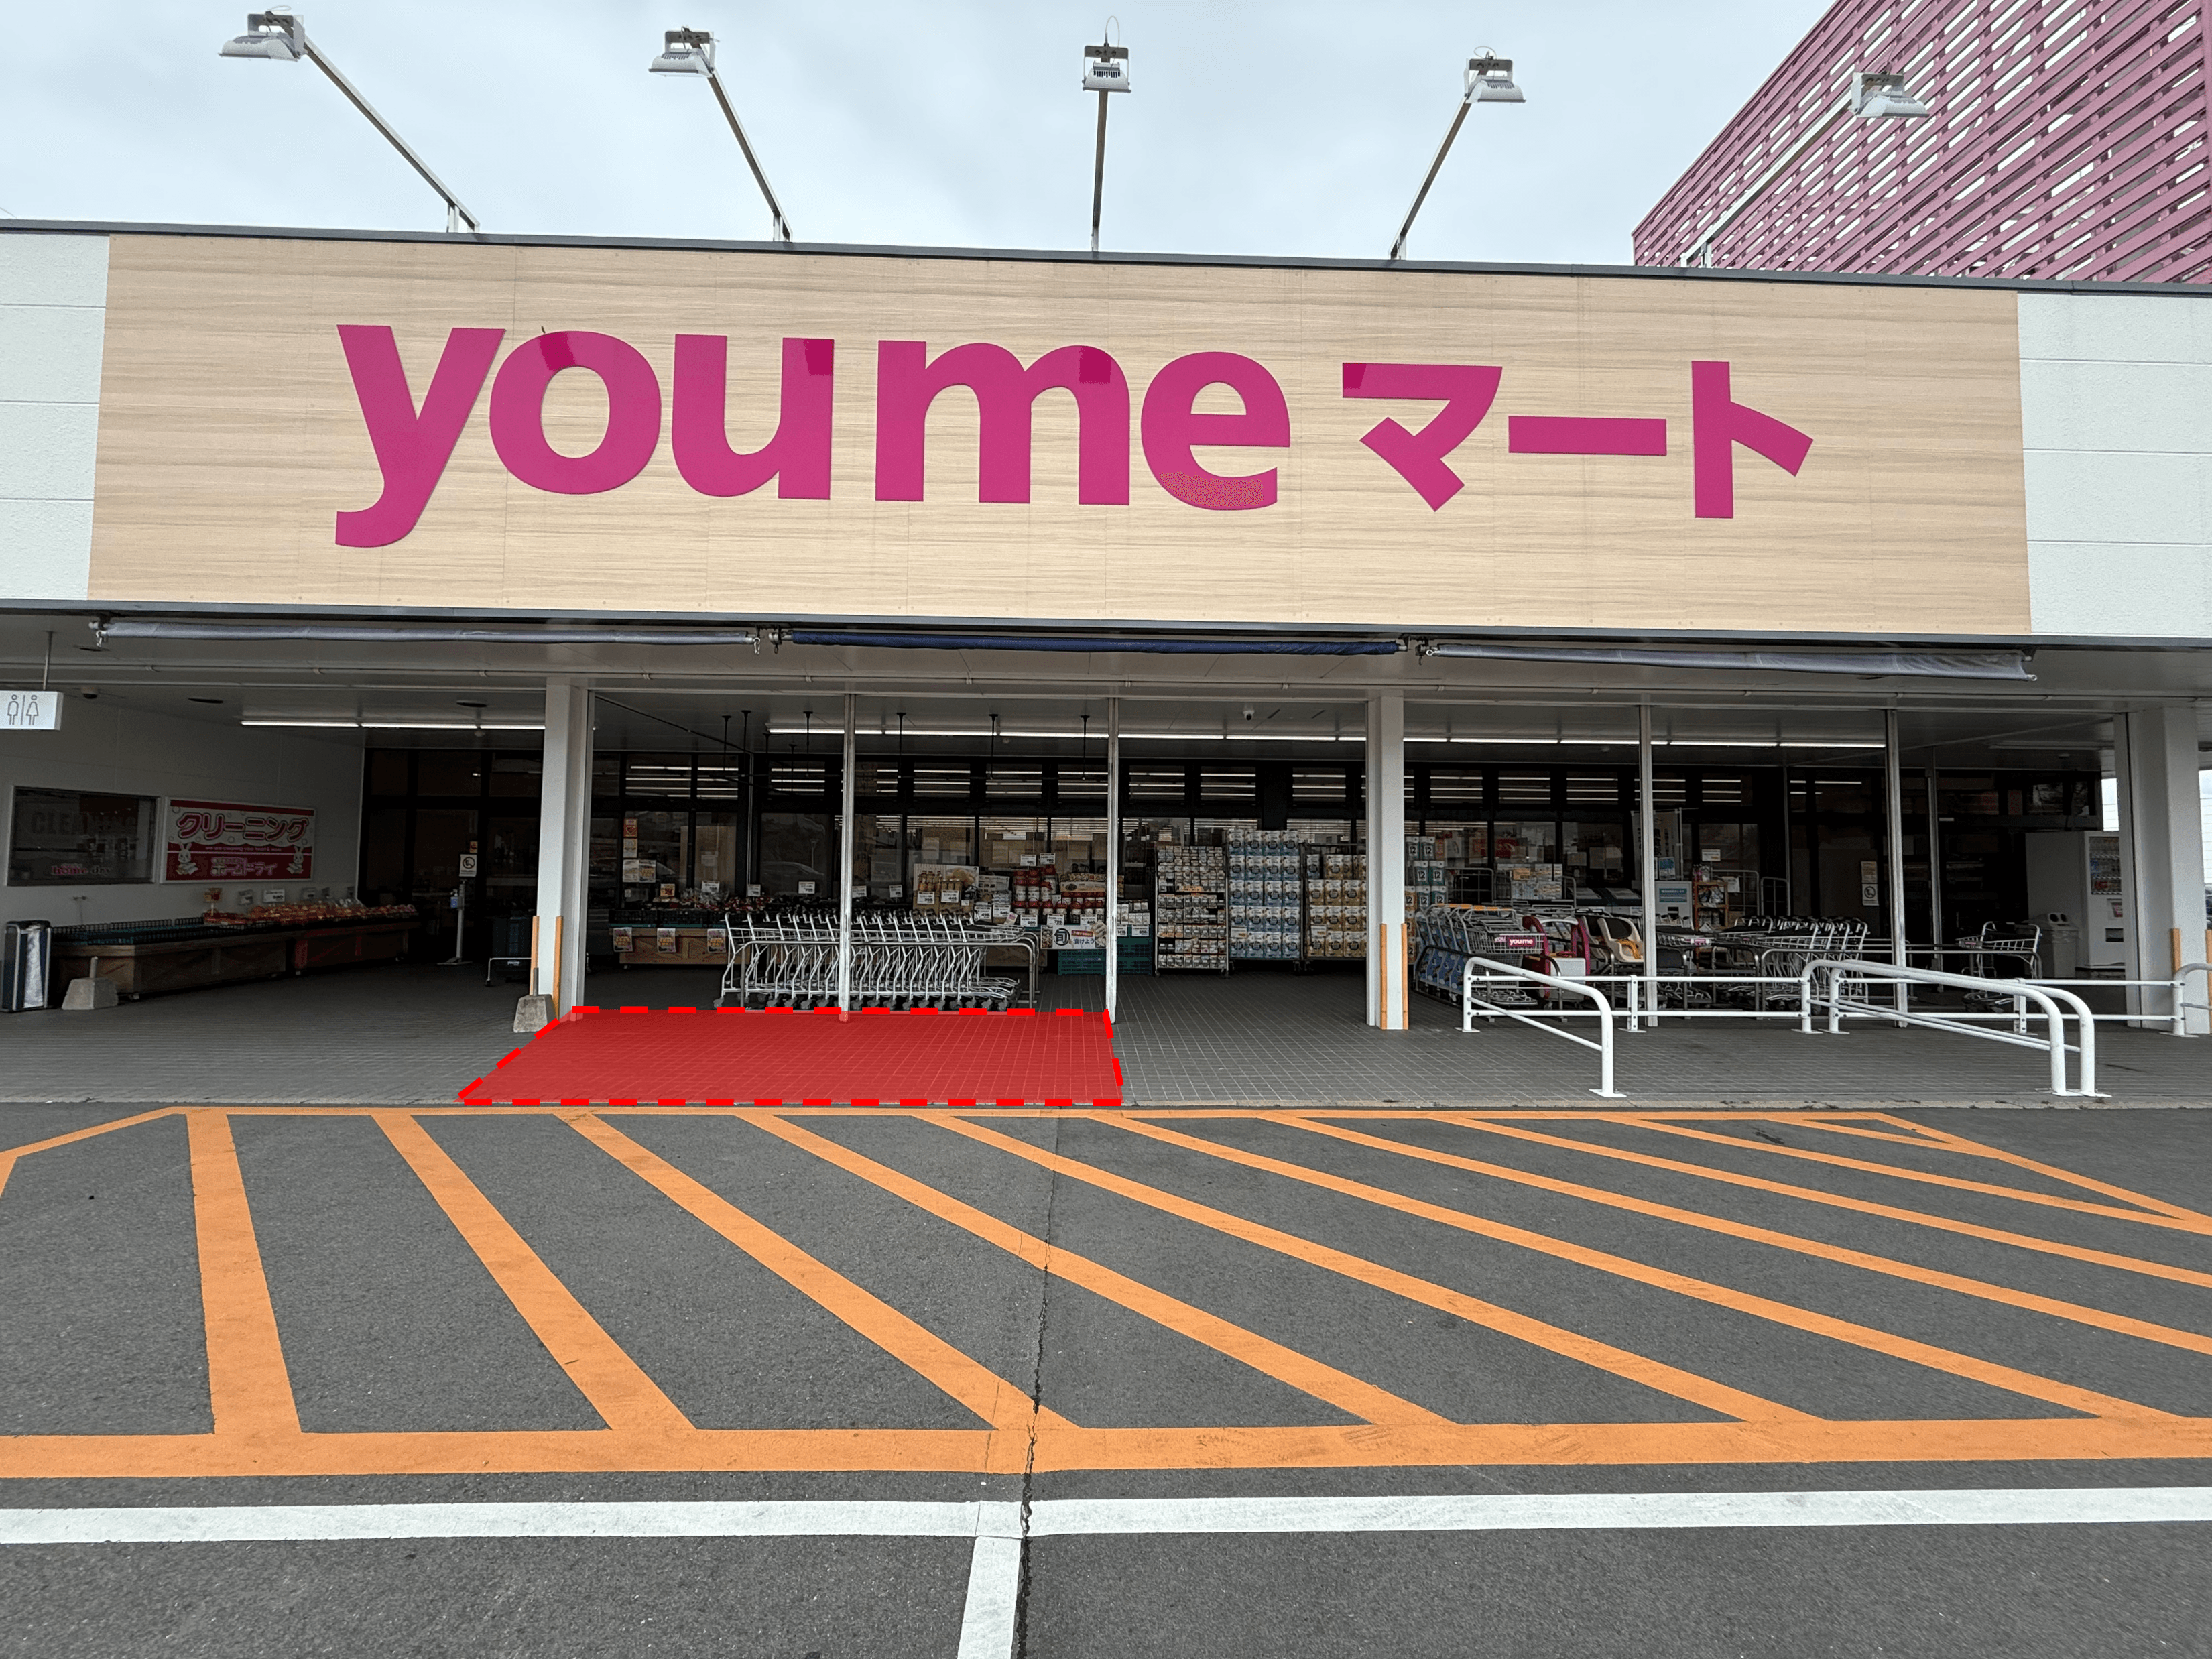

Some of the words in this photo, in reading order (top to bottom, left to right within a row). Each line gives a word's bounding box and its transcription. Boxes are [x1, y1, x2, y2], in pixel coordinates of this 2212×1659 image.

[1343, 361, 1813, 518] マート
[176, 812, 309, 842] クリーニング
[210, 858, 278, 876] ホームドライ
